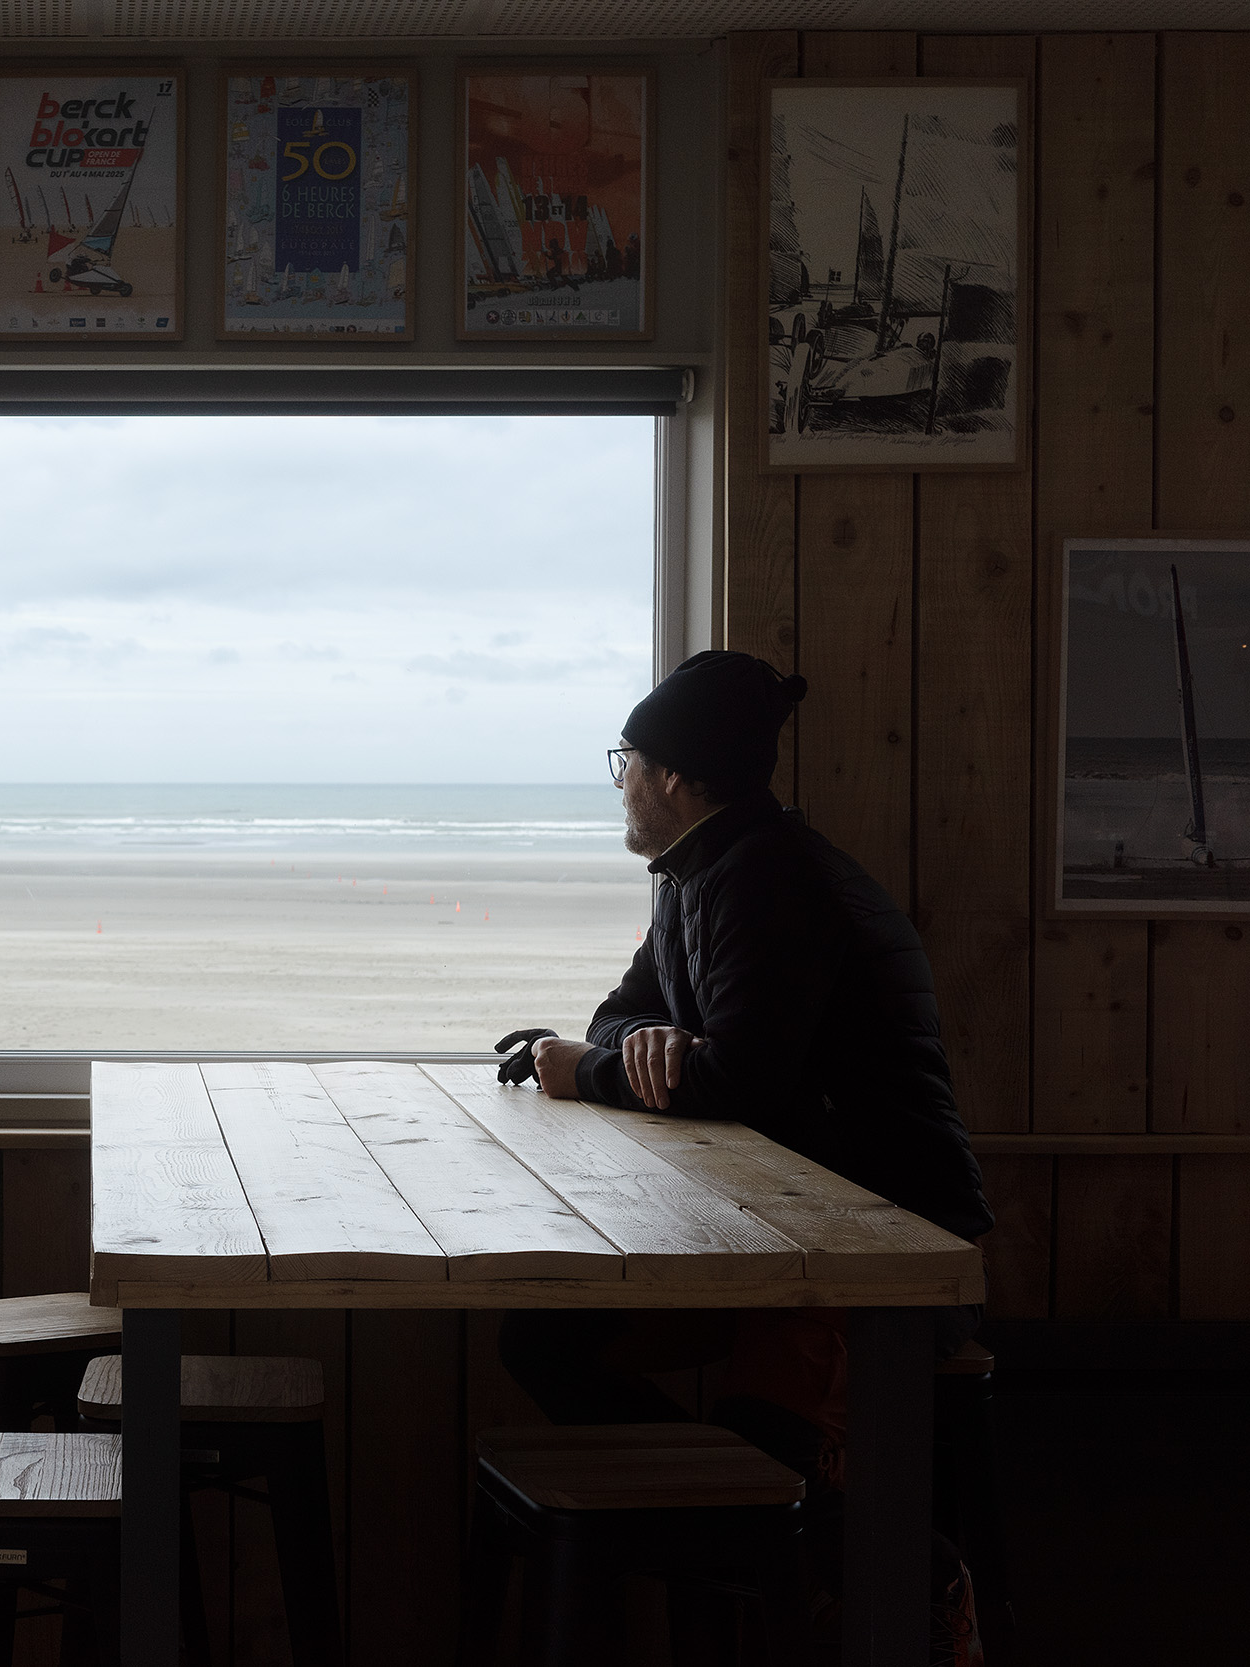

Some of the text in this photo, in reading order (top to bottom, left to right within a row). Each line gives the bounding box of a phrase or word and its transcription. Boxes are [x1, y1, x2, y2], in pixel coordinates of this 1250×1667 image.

[37, 92, 136, 119] berck
[29, 120, 149, 147] blokart
[26, 148, 86, 168] CUP
[85, 158, 117, 166] FRANCE
[281, 140, 357, 182] 50
[282, 184, 356, 203] 6 HEURES
[282, 202, 356, 219] DE BERCK
[522, 195, 550, 221] 13
